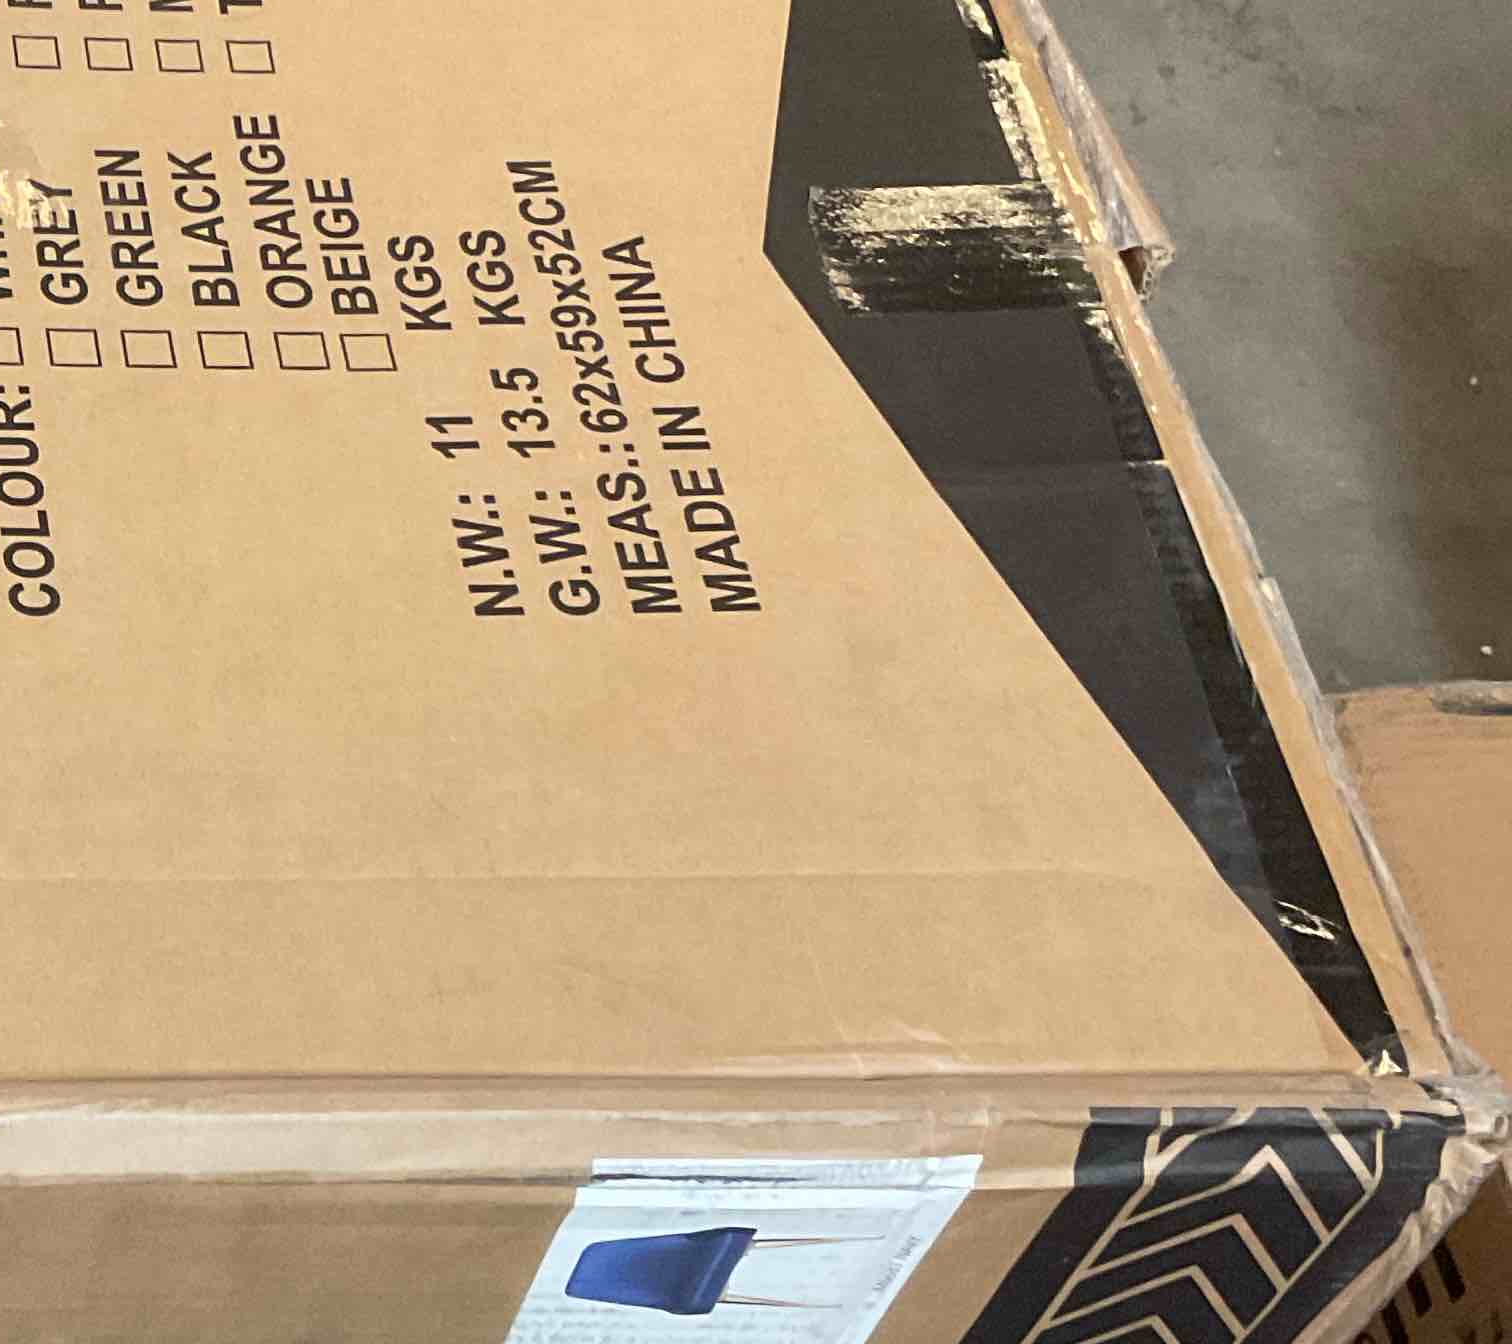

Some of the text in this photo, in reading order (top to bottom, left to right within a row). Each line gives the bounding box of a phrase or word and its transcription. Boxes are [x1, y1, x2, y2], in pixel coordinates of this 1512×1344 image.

[26, 178, 89, 306] GREY
[94, 149, 164, 307] GREEN
[167, 151, 241, 307] BLACK
[233, 114, 313, 309] ORANGE
[305, 176, 378, 315] BEIGE
[388, 233, 526, 617] N.W.: 11 KGS
[459, 229, 601, 617] G.W.: 13.5 KGS
[602, 234, 763, 613] MADE IN CHINA
